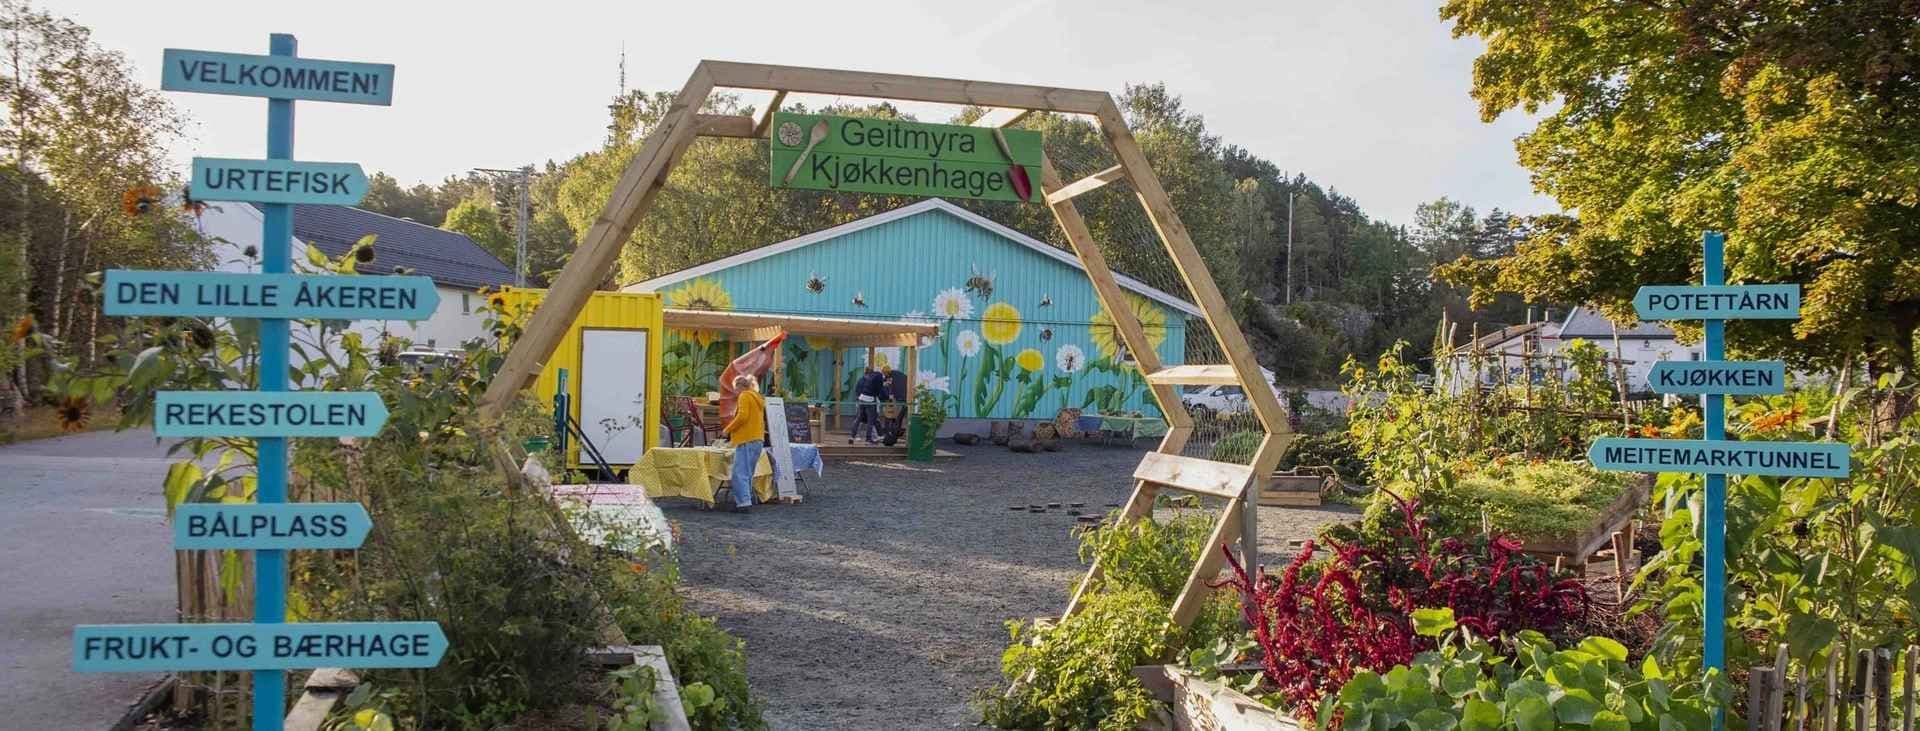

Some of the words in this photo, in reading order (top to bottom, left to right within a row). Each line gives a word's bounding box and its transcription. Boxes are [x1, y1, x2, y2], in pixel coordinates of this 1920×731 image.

[179, 59, 380, 96] VELKOMMEN!
[841, 119, 976, 157] Geitmyra
[205, 168, 352, 195] URTEFISK
[811, 153, 1003, 197] Kjøkkenhage
[118, 282, 179, 305] DEN
[196, 283, 278, 307] LILLE
[294, 282, 417, 310] ÅKEREN
[1649, 290, 1789, 310] POTETTÅRN
[1660, 369, 1773, 386] KJØKKEN
[166, 403, 366, 427] REKESTOLEN
[1605, 447, 1840, 470] MEITEMARKTUNNEL
[188, 511, 347, 537] BÅLPLASS
[84, 636, 198, 660] FRUKT-
[212, 635, 257, 657] OG
[274, 634, 429, 658] BÆRHAGE
